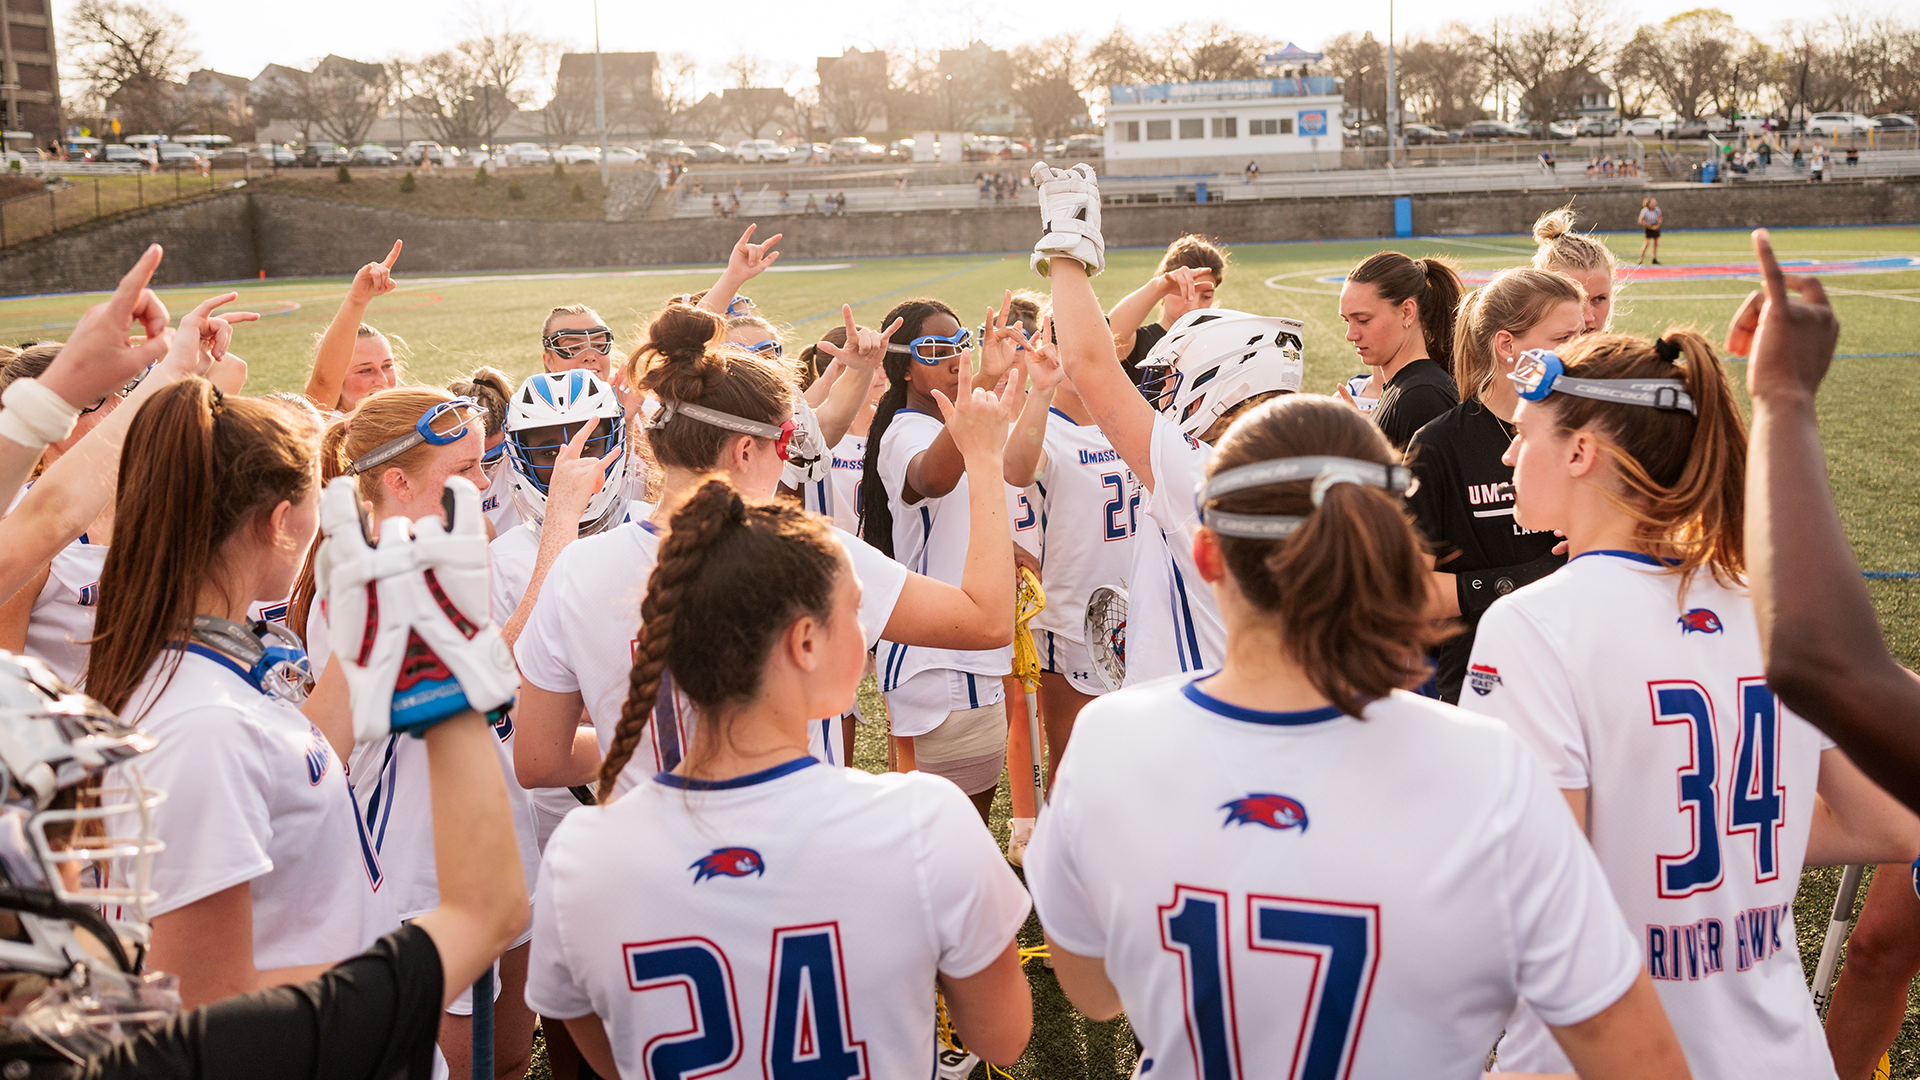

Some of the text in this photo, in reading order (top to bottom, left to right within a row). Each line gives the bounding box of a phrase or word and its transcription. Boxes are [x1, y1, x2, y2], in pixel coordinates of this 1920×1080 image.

[683, 406, 763, 433] cascade
[366, 436, 416, 466] cascade
[831, 452, 864, 471] MASS
[1033, 764, 1041, 788] GAIT
[1647, 675, 1786, 899] 34
[1157, 883, 1381, 1080] 17
[622, 920, 871, 1080] 24
